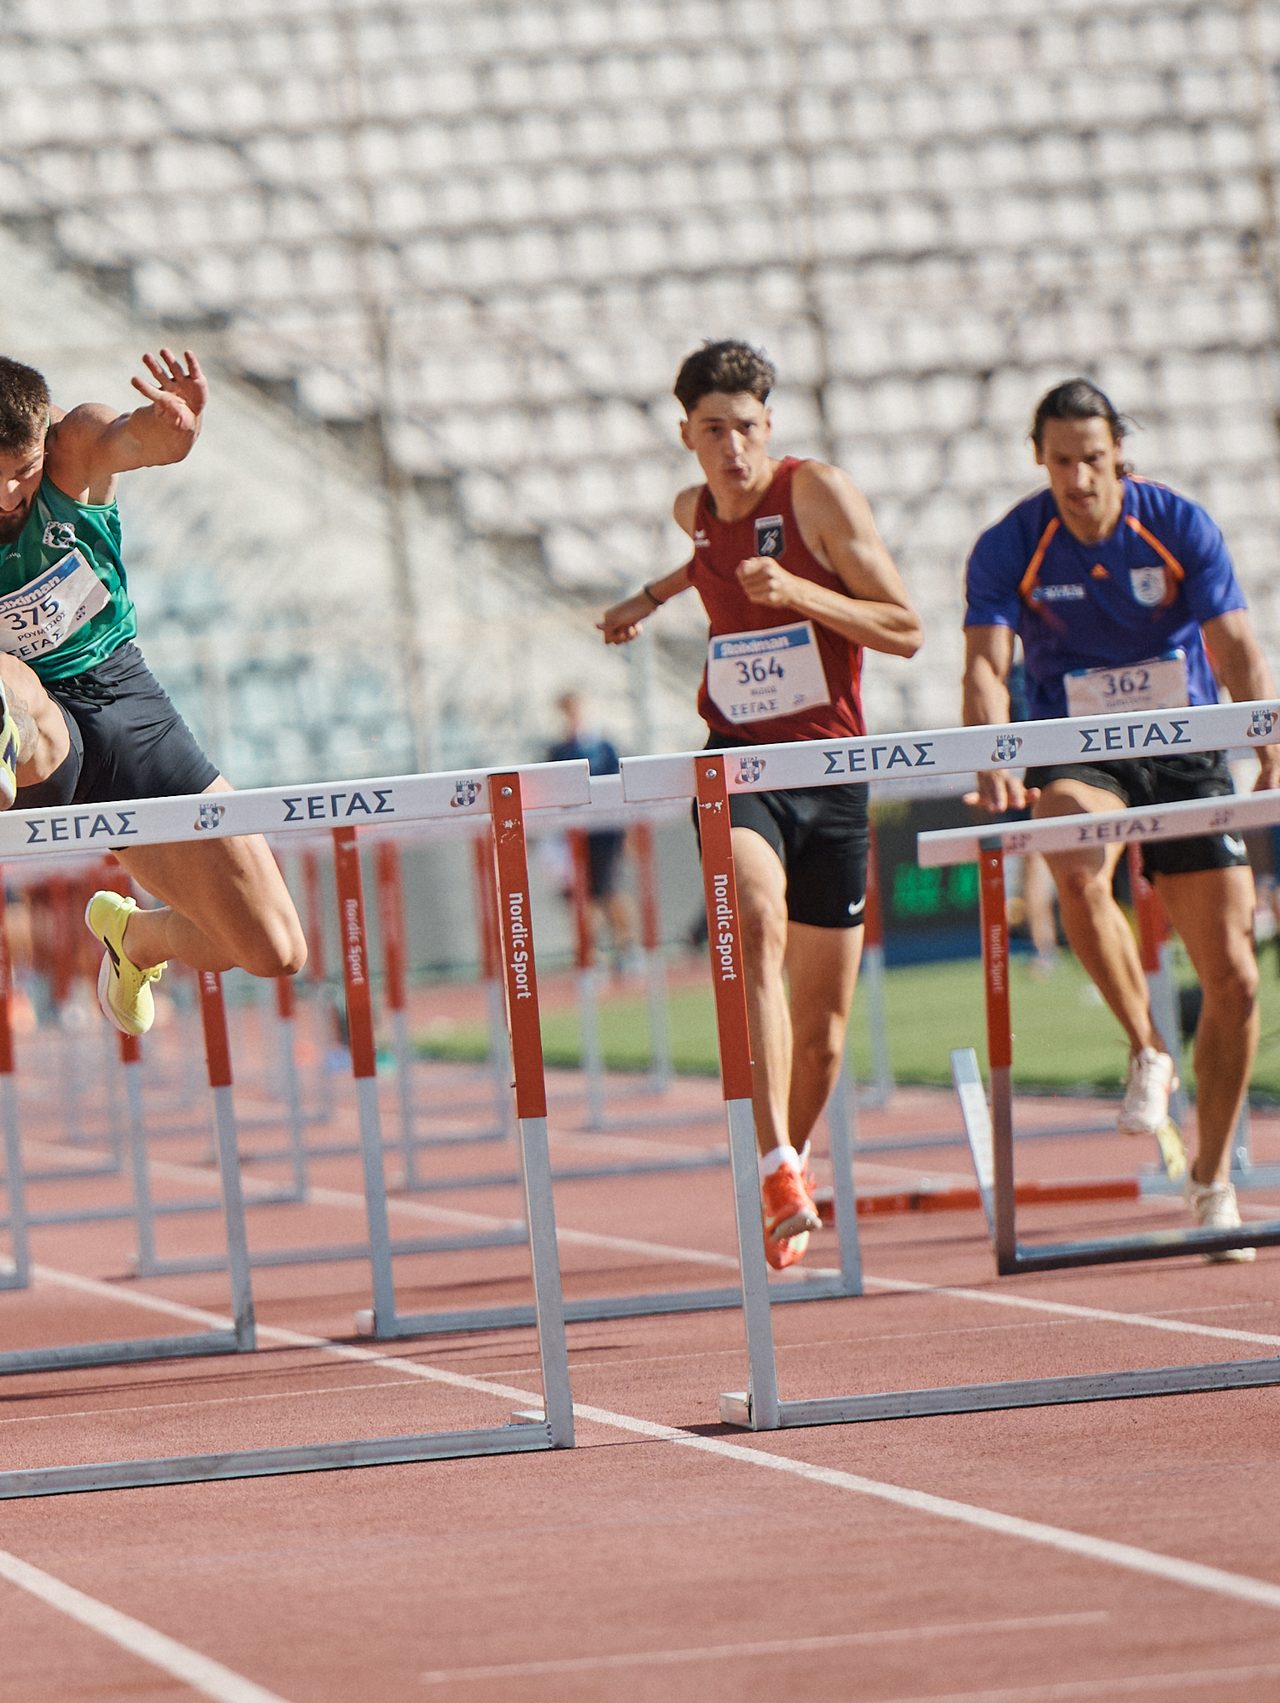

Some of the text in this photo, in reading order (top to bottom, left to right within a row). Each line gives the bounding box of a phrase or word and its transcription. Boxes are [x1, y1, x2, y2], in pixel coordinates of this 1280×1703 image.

[4, 595, 60, 630] 375
[735, 656, 785, 684] 364
[1102, 669, 1151, 696] 362
[730, 699, 779, 716] ΣΕΓΑΣ
[1079, 720, 1192, 753] ΣΕΓΑΣ
[822, 742, 936, 775] ΣΕΓΑΣ
[282, 789, 395, 823] ΣΕΓΑΣ
[25, 811, 139, 844] ΣΕΓΑΣ
[1076, 816, 1162, 842] ΣΕΓΑΣ
[344, 898, 365, 985] nordic Sport
[714, 874, 737, 981] nordic Sport
[509, 892, 532, 1000] nordic Sport
